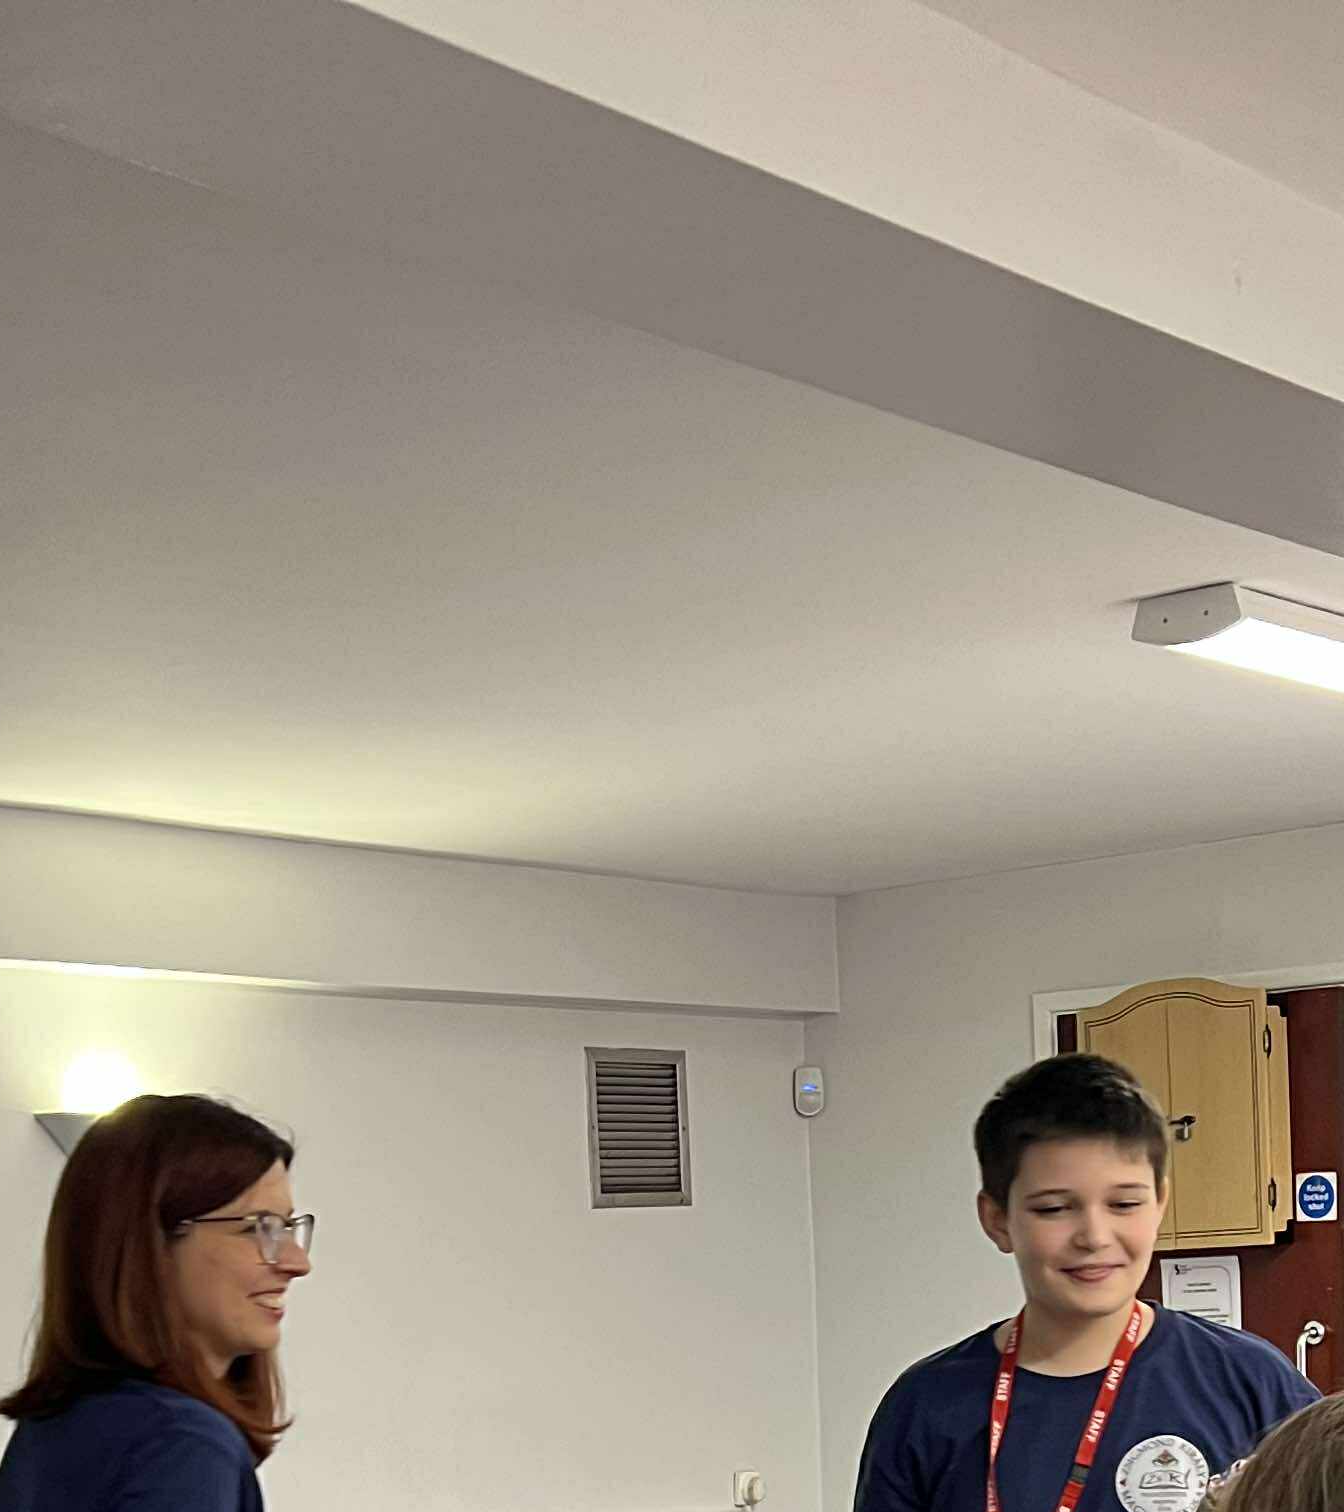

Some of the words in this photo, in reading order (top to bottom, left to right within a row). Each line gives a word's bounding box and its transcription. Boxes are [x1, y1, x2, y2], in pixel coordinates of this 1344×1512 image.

[994, 1371, 1012, 1402] STAFF
[1105, 1358, 1126, 1391] STAFF
[1086, 1410, 1106, 1443] STAFF
